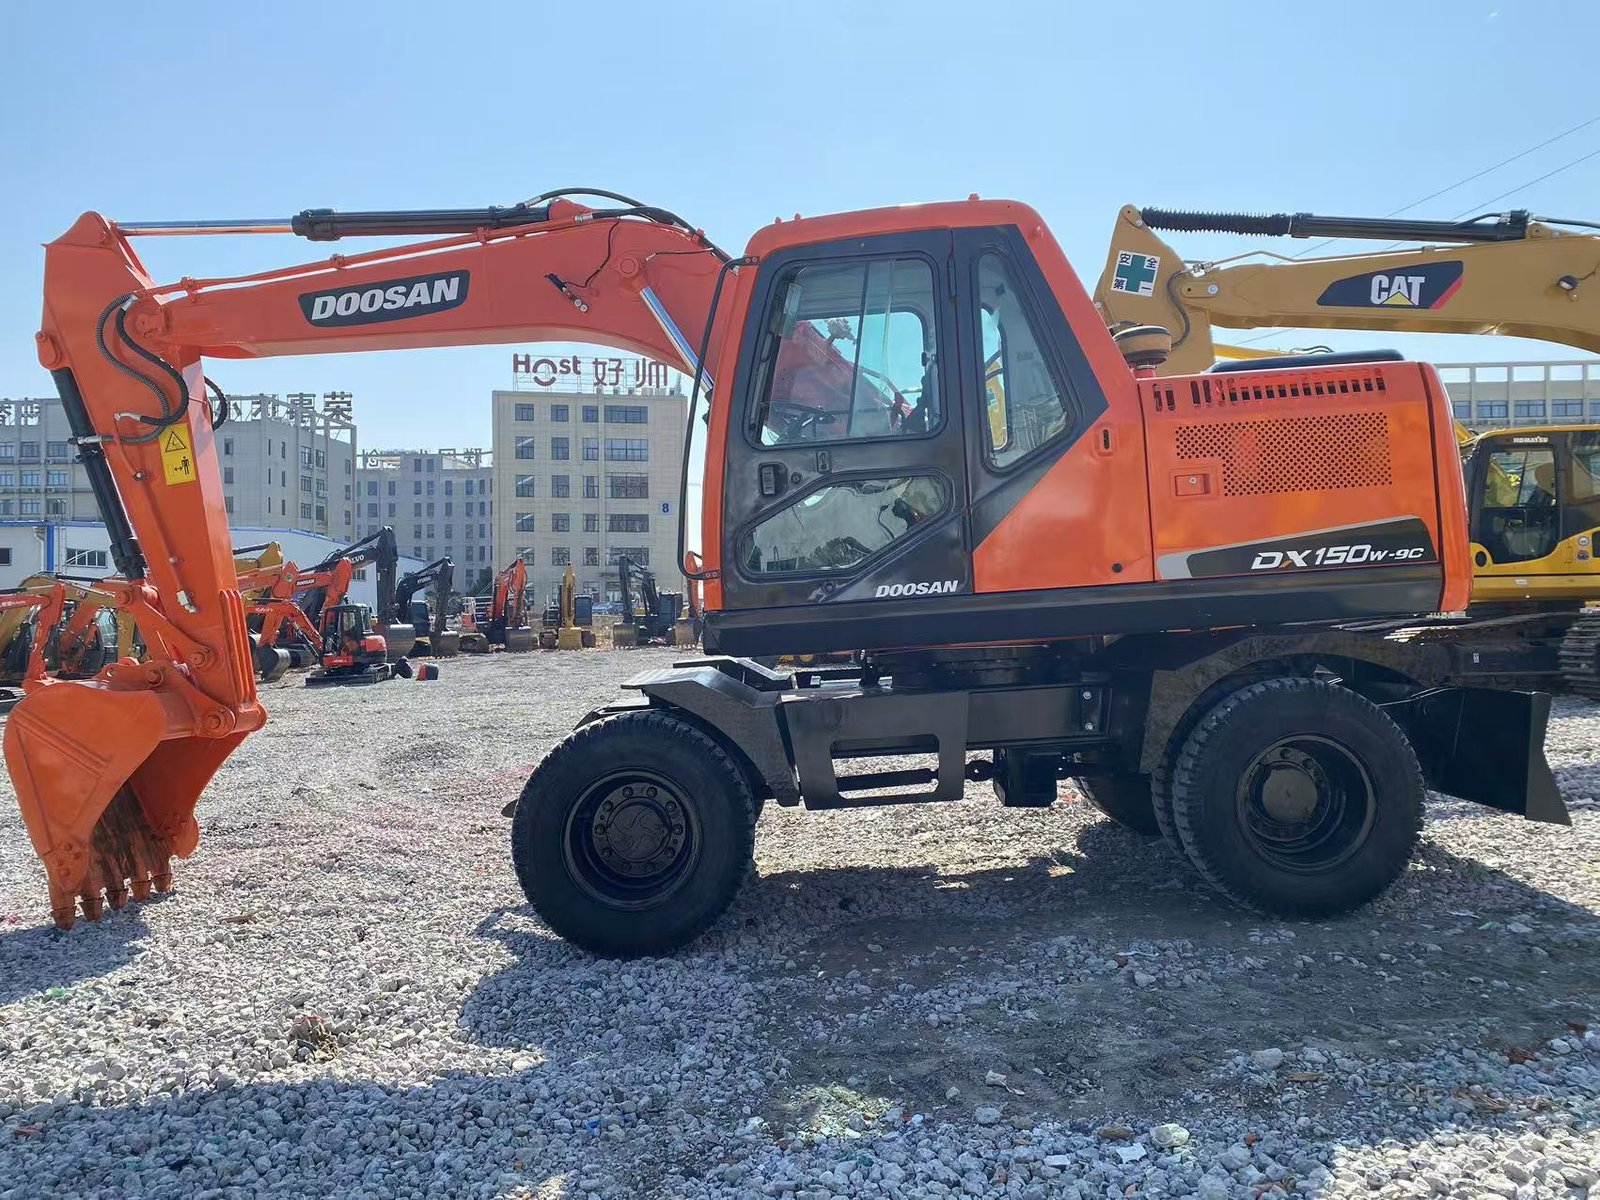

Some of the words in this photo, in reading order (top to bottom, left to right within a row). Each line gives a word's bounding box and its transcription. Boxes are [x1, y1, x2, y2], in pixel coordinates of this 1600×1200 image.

[311, 277, 460, 320] DOOSAN
[1370, 274, 1426, 306] CAT
[513, 353, 581, 387] Host
[1513, 436, 1549, 444] KOMATSU
[662, 502, 670, 513] 8
[1251, 544, 1425, 569] DX150W-9C
[875, 580, 959, 598] DOOSAN
